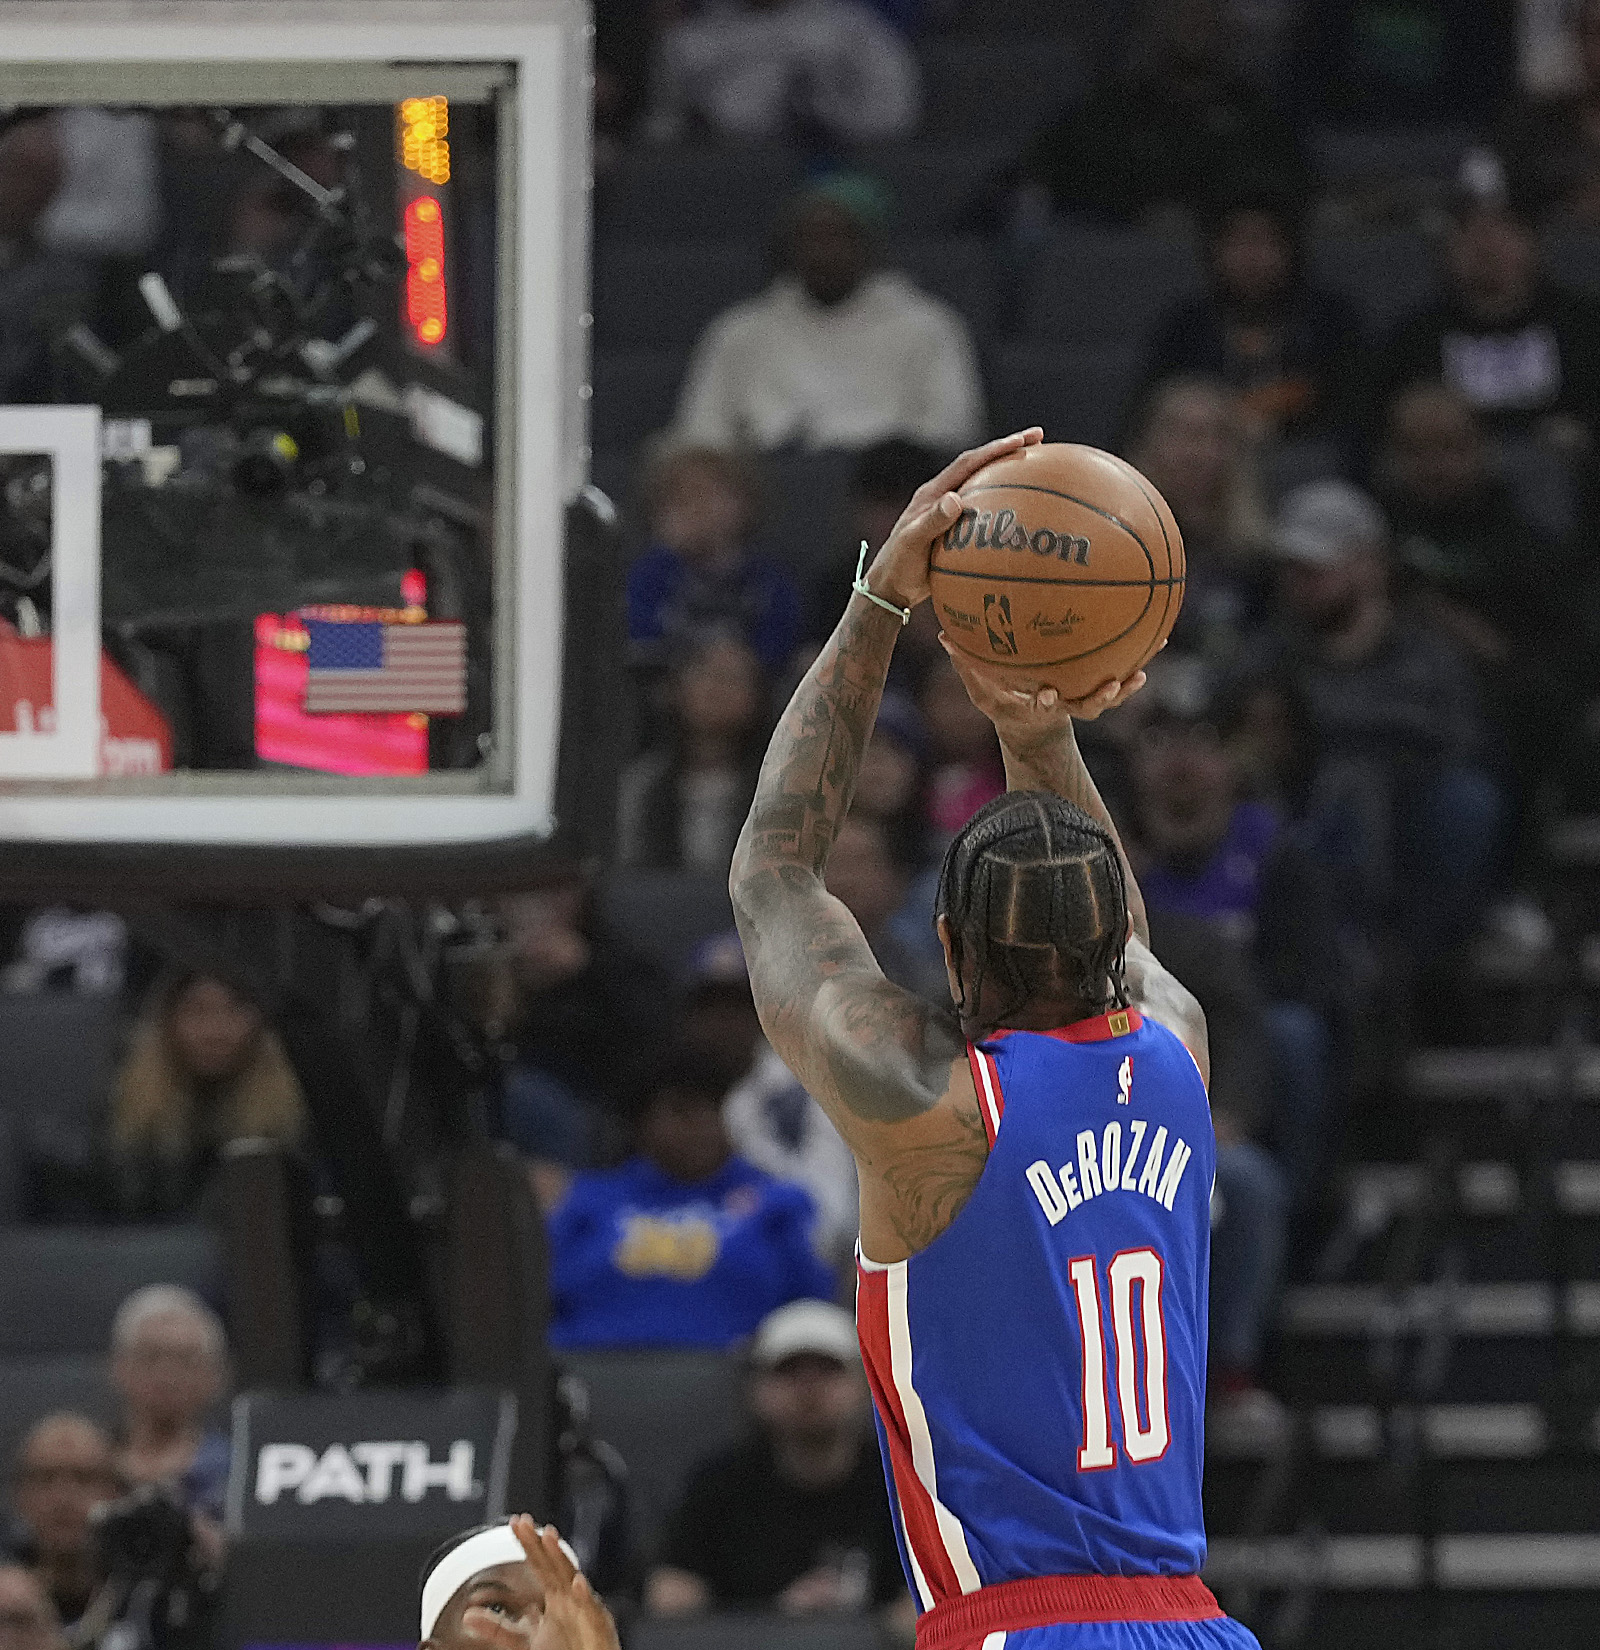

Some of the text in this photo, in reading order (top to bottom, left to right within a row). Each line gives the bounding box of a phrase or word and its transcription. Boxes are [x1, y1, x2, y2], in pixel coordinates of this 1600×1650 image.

[943, 508, 1091, 566] Wilson
[1068, 1246, 1172, 1472] 10
[255, 1440, 476, 1504] PATH
